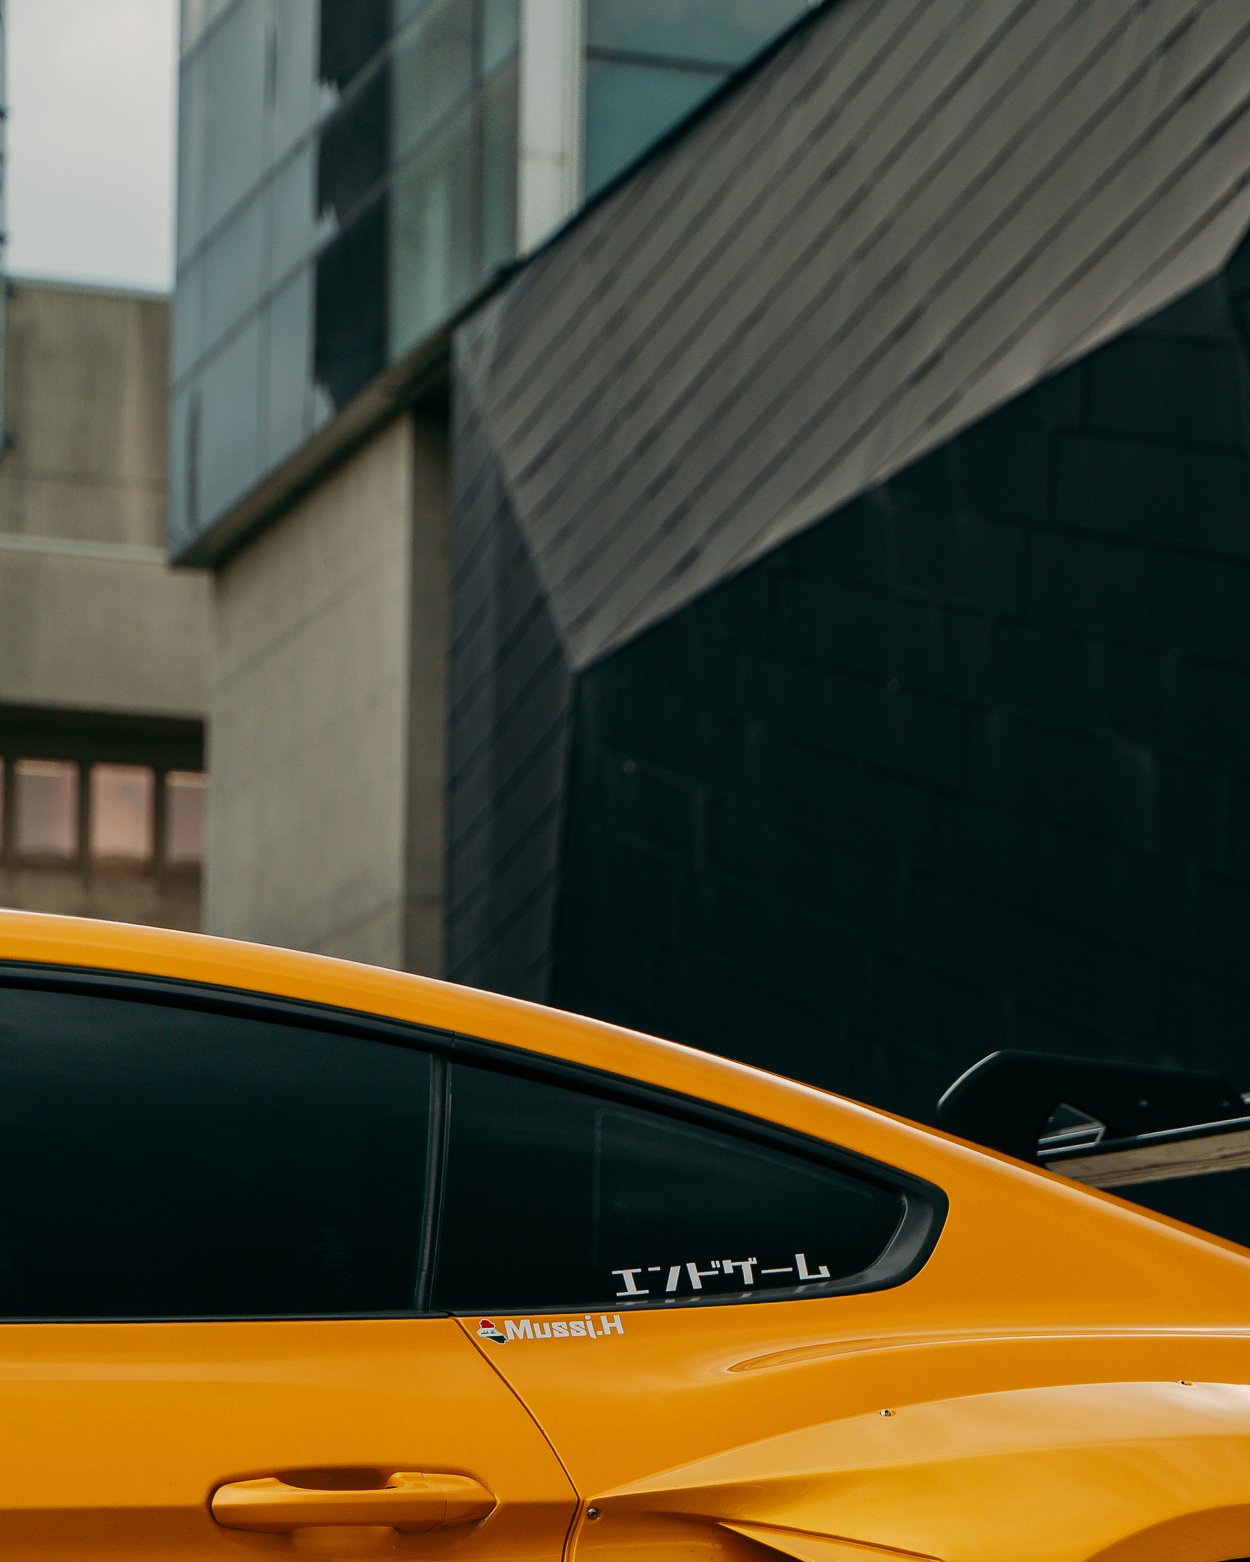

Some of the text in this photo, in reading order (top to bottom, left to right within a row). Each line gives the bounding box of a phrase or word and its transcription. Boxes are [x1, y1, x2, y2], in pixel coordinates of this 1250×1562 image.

[611, 1252, 831, 1297] エンドゲーム
